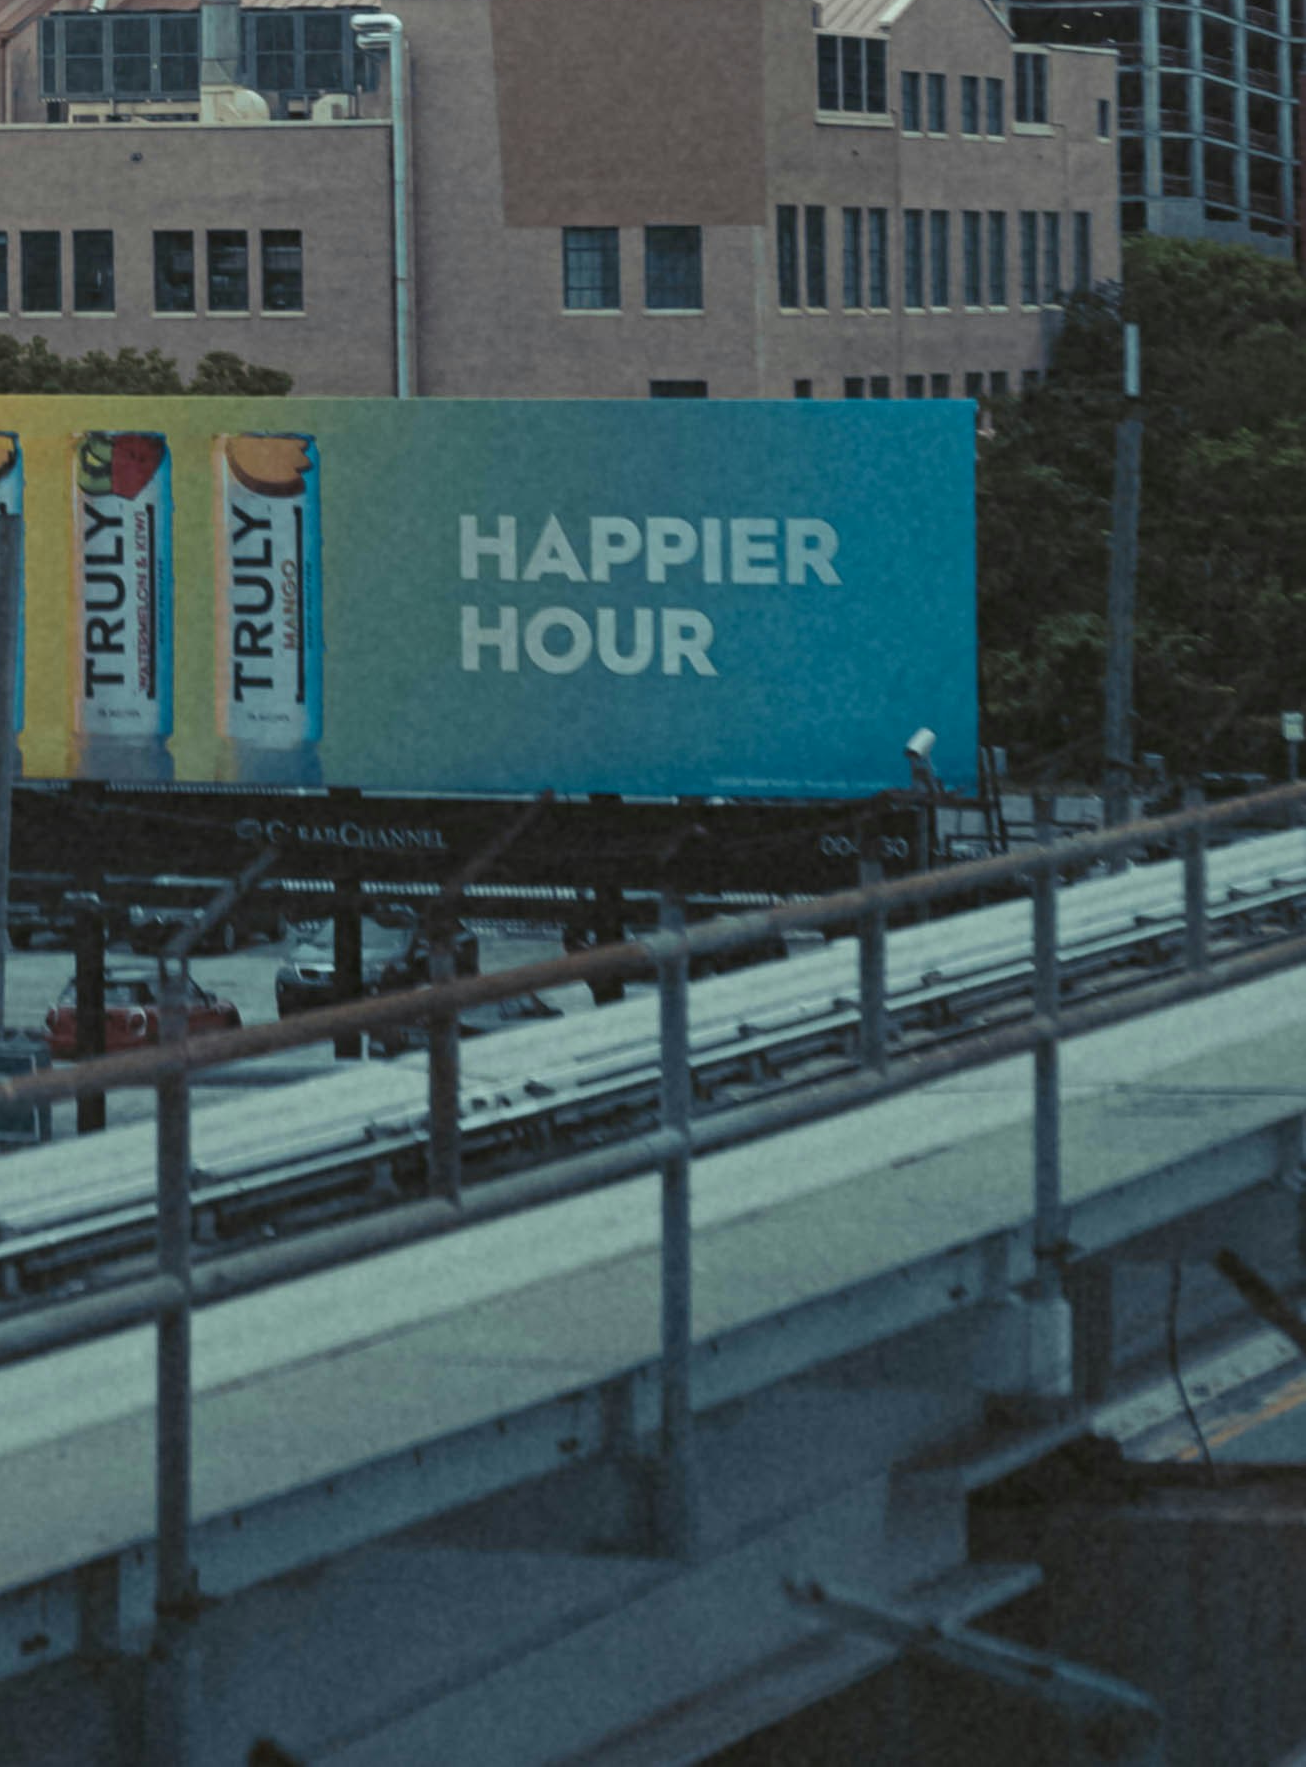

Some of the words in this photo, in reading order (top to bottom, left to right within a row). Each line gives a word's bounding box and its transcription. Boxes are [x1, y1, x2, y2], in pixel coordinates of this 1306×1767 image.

[459, 513, 844, 585] HAPPIER
[83, 503, 126, 699] TRULY
[232, 504, 275, 702] TRULY
[280, 560, 296, 650] MANGO
[461, 605, 718, 676] HOUR
